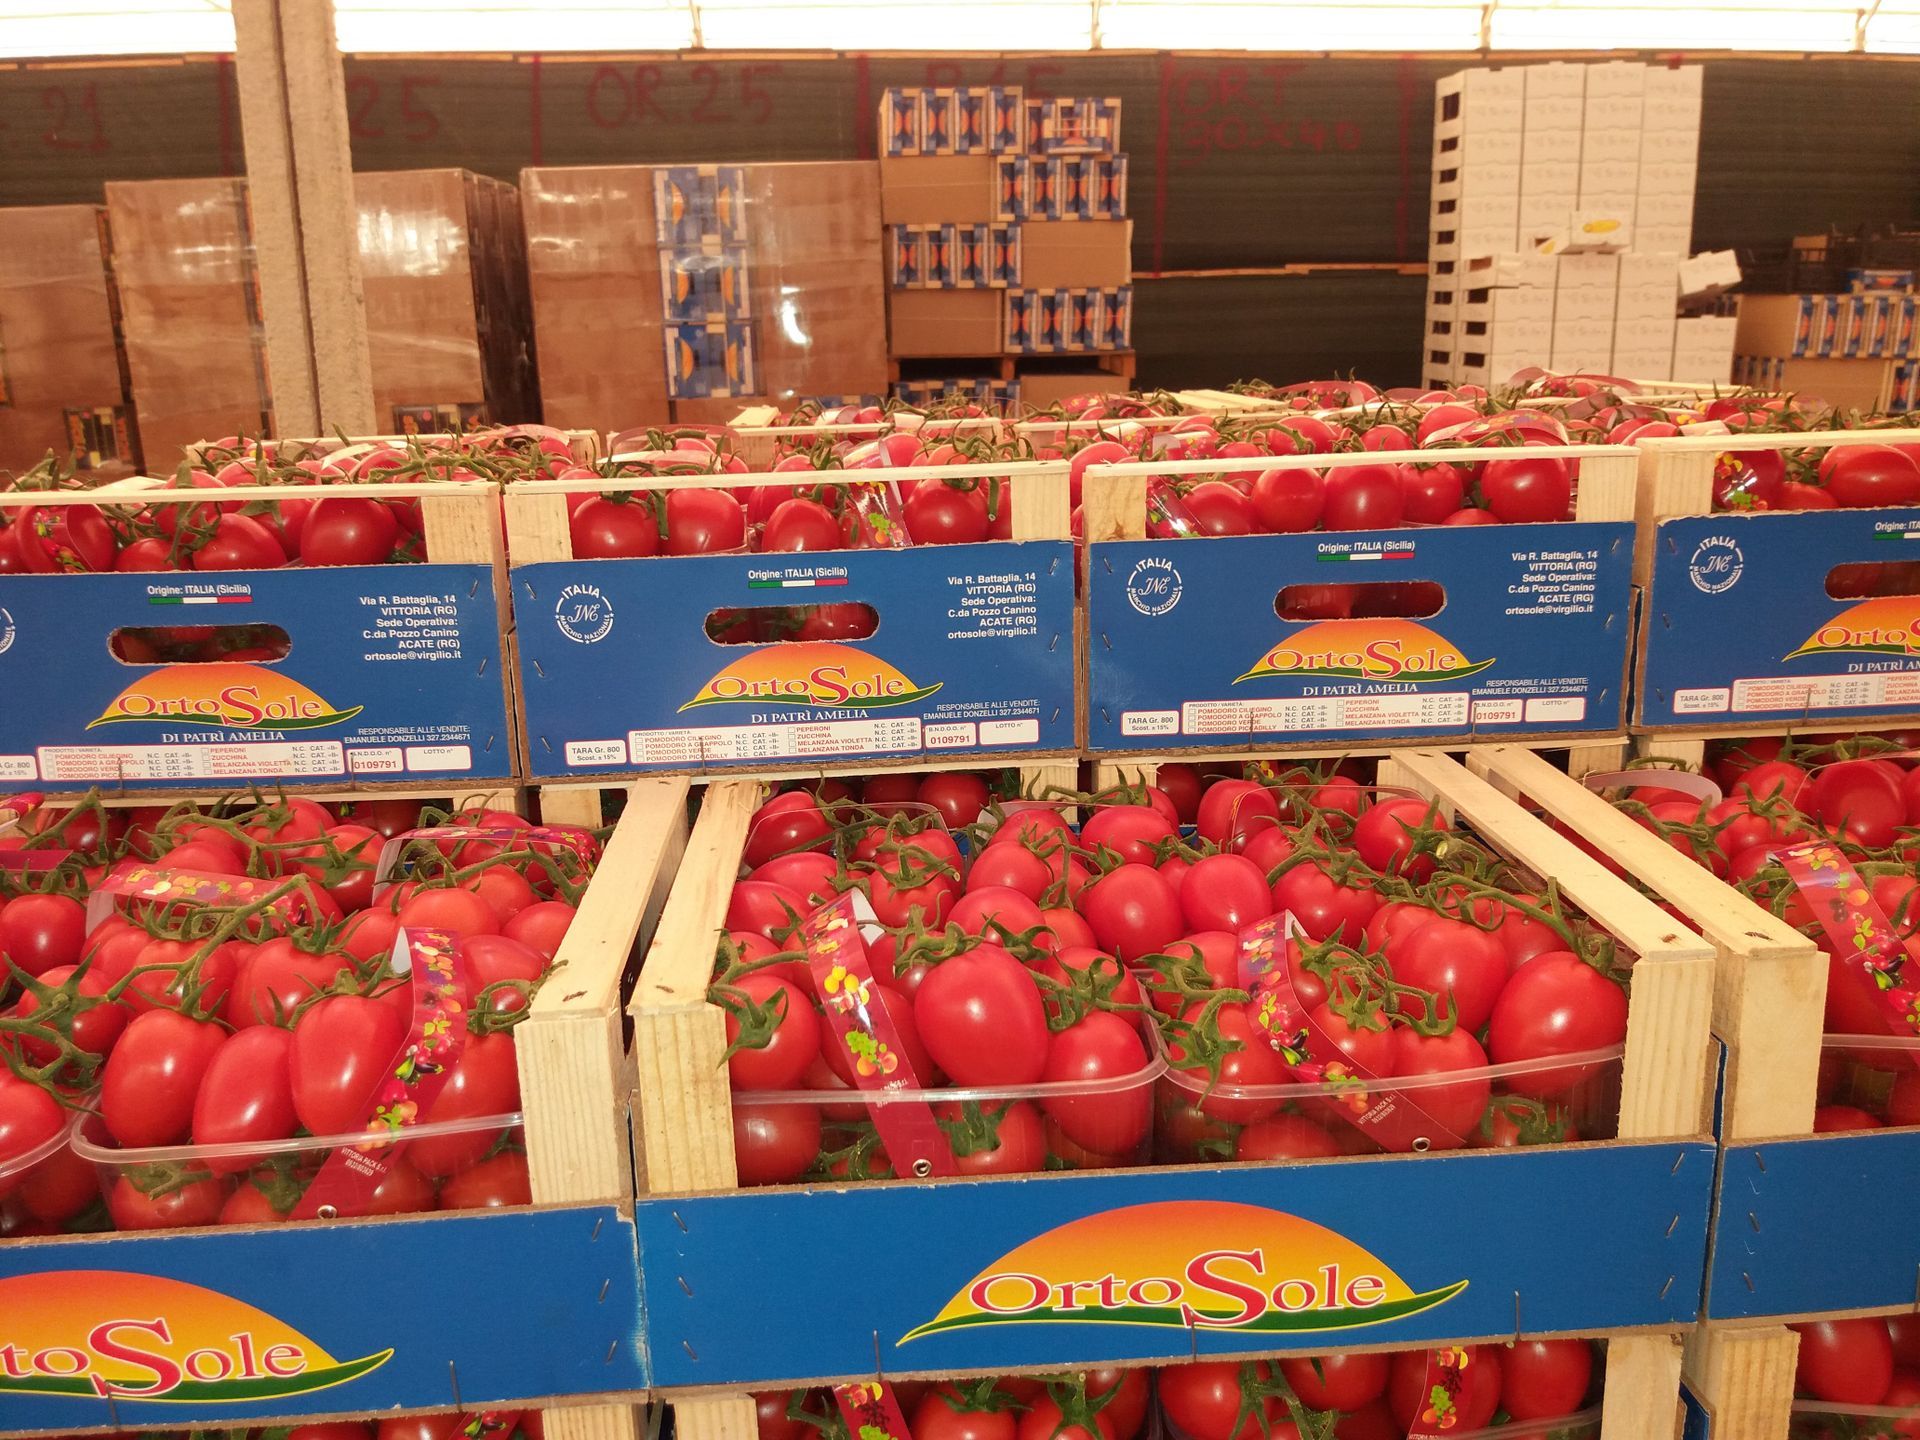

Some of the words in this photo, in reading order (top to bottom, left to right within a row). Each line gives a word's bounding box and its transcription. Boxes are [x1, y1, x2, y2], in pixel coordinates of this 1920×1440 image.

[1875, 521, 1907, 532] Origine:
[1908, 520, 1920, 529] ITA
[1318, 543, 1352, 554] Origine:
[1353, 542, 1382, 551] ITALIA
[1383, 541, 1416, 551] (Sicilia)
[1699, 535, 1736, 550] ITALIA
[1511, 552, 1527, 561] Via
[1528, 552, 1539, 560] R.
[1540, 551, 1584, 561] Battaglia,
[1587, 550, 1598, 559] 14
[1136, 557, 1172, 573] ITALIA
[1529, 562, 1574, 571] VITTORIA
[1575, 561, 1597, 571] (RG)
[748, 570, 783, 581] Origine:
[784, 568, 814, 578] ITALIA
[815, 567, 848, 578] (Sicilia)
[947, 576, 963, 585] Via
[965, 575, 975, 584] R.
[977, 573, 1022, 584] Battaglia,
[1024, 572, 1036, 581] 14
[1522, 573, 1546, 582] Sede
[1547, 573, 1596, 583] Operativa:
[147, 585, 184, 596] Origine:
[184, 585, 215, 594] ITALIA
[216, 584, 252, 595] (Sicilia)
[561, 583, 600, 600] ITALIA
[966, 584, 1013, 595] VITTORIA
[1014, 583, 1036, 594] (RG)
[1508, 584, 1530, 593] C.da
[1531, 584, 1560, 592] Pozzo
[1561, 583, 1595, 592] Canino
[360, 596, 377, 605] Via
[378, 596, 390, 605] R.
[392, 595, 441, 605] Battaglia,
[443, 594, 456, 603] 14
[961, 597, 985, 606] Sede
[987, 595, 1036, 606] Operativa:
[1130, 587, 1151, 612] MARCHIO
[1537, 594, 1571, 603] ACATE
[1572, 594, 1594, 603] (RG)
[381, 606, 432, 616] VITTORIA
[433, 605, 457, 616] (RG)
[948, 608, 970, 618] C.da
[972, 607, 1001, 616] Pozzo
[1003, 605, 1036, 615] Canino
[1505, 604, 1593, 615] ortosole@virgilio.it
[376, 618, 403, 628] Sede
[405, 617, 458, 628] Operativa:
[980, 617, 1012, 626] ACATE
[1015, 615, 1037, 626] (RG)
[560, 614, 583, 639] MARCHIO
[584, 614, 610, 640] NAZIONALE
[947, 626, 1037, 639] ortosole@virgilio.it
[363, 629, 387, 639] C.da
[389, 629, 421, 638] Pozzo
[422, 628, 459, 637] Canino
[1815, 617, 1920, 655] Orto
[398, 640, 435, 649] ACATE
[437, 639, 460, 649] (RG)
[364, 650, 462, 661] ortosole@virgilio.it
[1266, 639, 1458, 680] OrtoSole
[1848, 662, 1863, 673] DI
[709, 665, 905, 706] OrtoSole
[1486, 679, 1540, 687] RESPONSABILE
[1558, 677, 1589, 685] VENDITE:
[1303, 686, 1319, 696] DI
[1323, 683, 1362, 695] PATRÌ
[1365, 683, 1418, 694] AMELIA
[117, 685, 323, 727] OrtoSole
[936, 702, 990, 711] RESPONSABILE
[1008, 699, 1041, 708] VENDITE:
[751, 713, 768, 723] DI
[771, 709, 811, 722] PATRÌ
[816, 708, 869, 720] AMELIA
[923, 711, 962, 720] EMANUELE
[963, 709, 998, 718] DONZELLI
[999, 707, 1040, 716] 327.2344671
[1476, 711, 1516, 720] 0109791
[1160, 716, 1174, 724] 800
[358, 727, 415, 735] RESPONSABILE
[436, 725, 471, 733] VENDITE:
[162, 733, 180, 743] DI
[183, 731, 225, 742] PATRÌ
[229, 731, 285, 741] AMELIA
[344, 735, 386, 744] EMANUELE
[387, 735, 425, 743] DONZELLI
[426, 734, 471, 742] 327.2344671
[930, 735, 970, 745] 0109791
[572, 747, 593, 755] TARA
[594, 746, 606, 754] Gr.
[17, 761, 30, 769] 800
[353, 760, 397, 770] 0109791
[341, 1147, 364, 1162] VITTORIA
[362, 1155, 378, 1169] PACK
[969, 1247, 1387, 1328] OrtoSole
[0, 1316, 307, 1398] toSole
